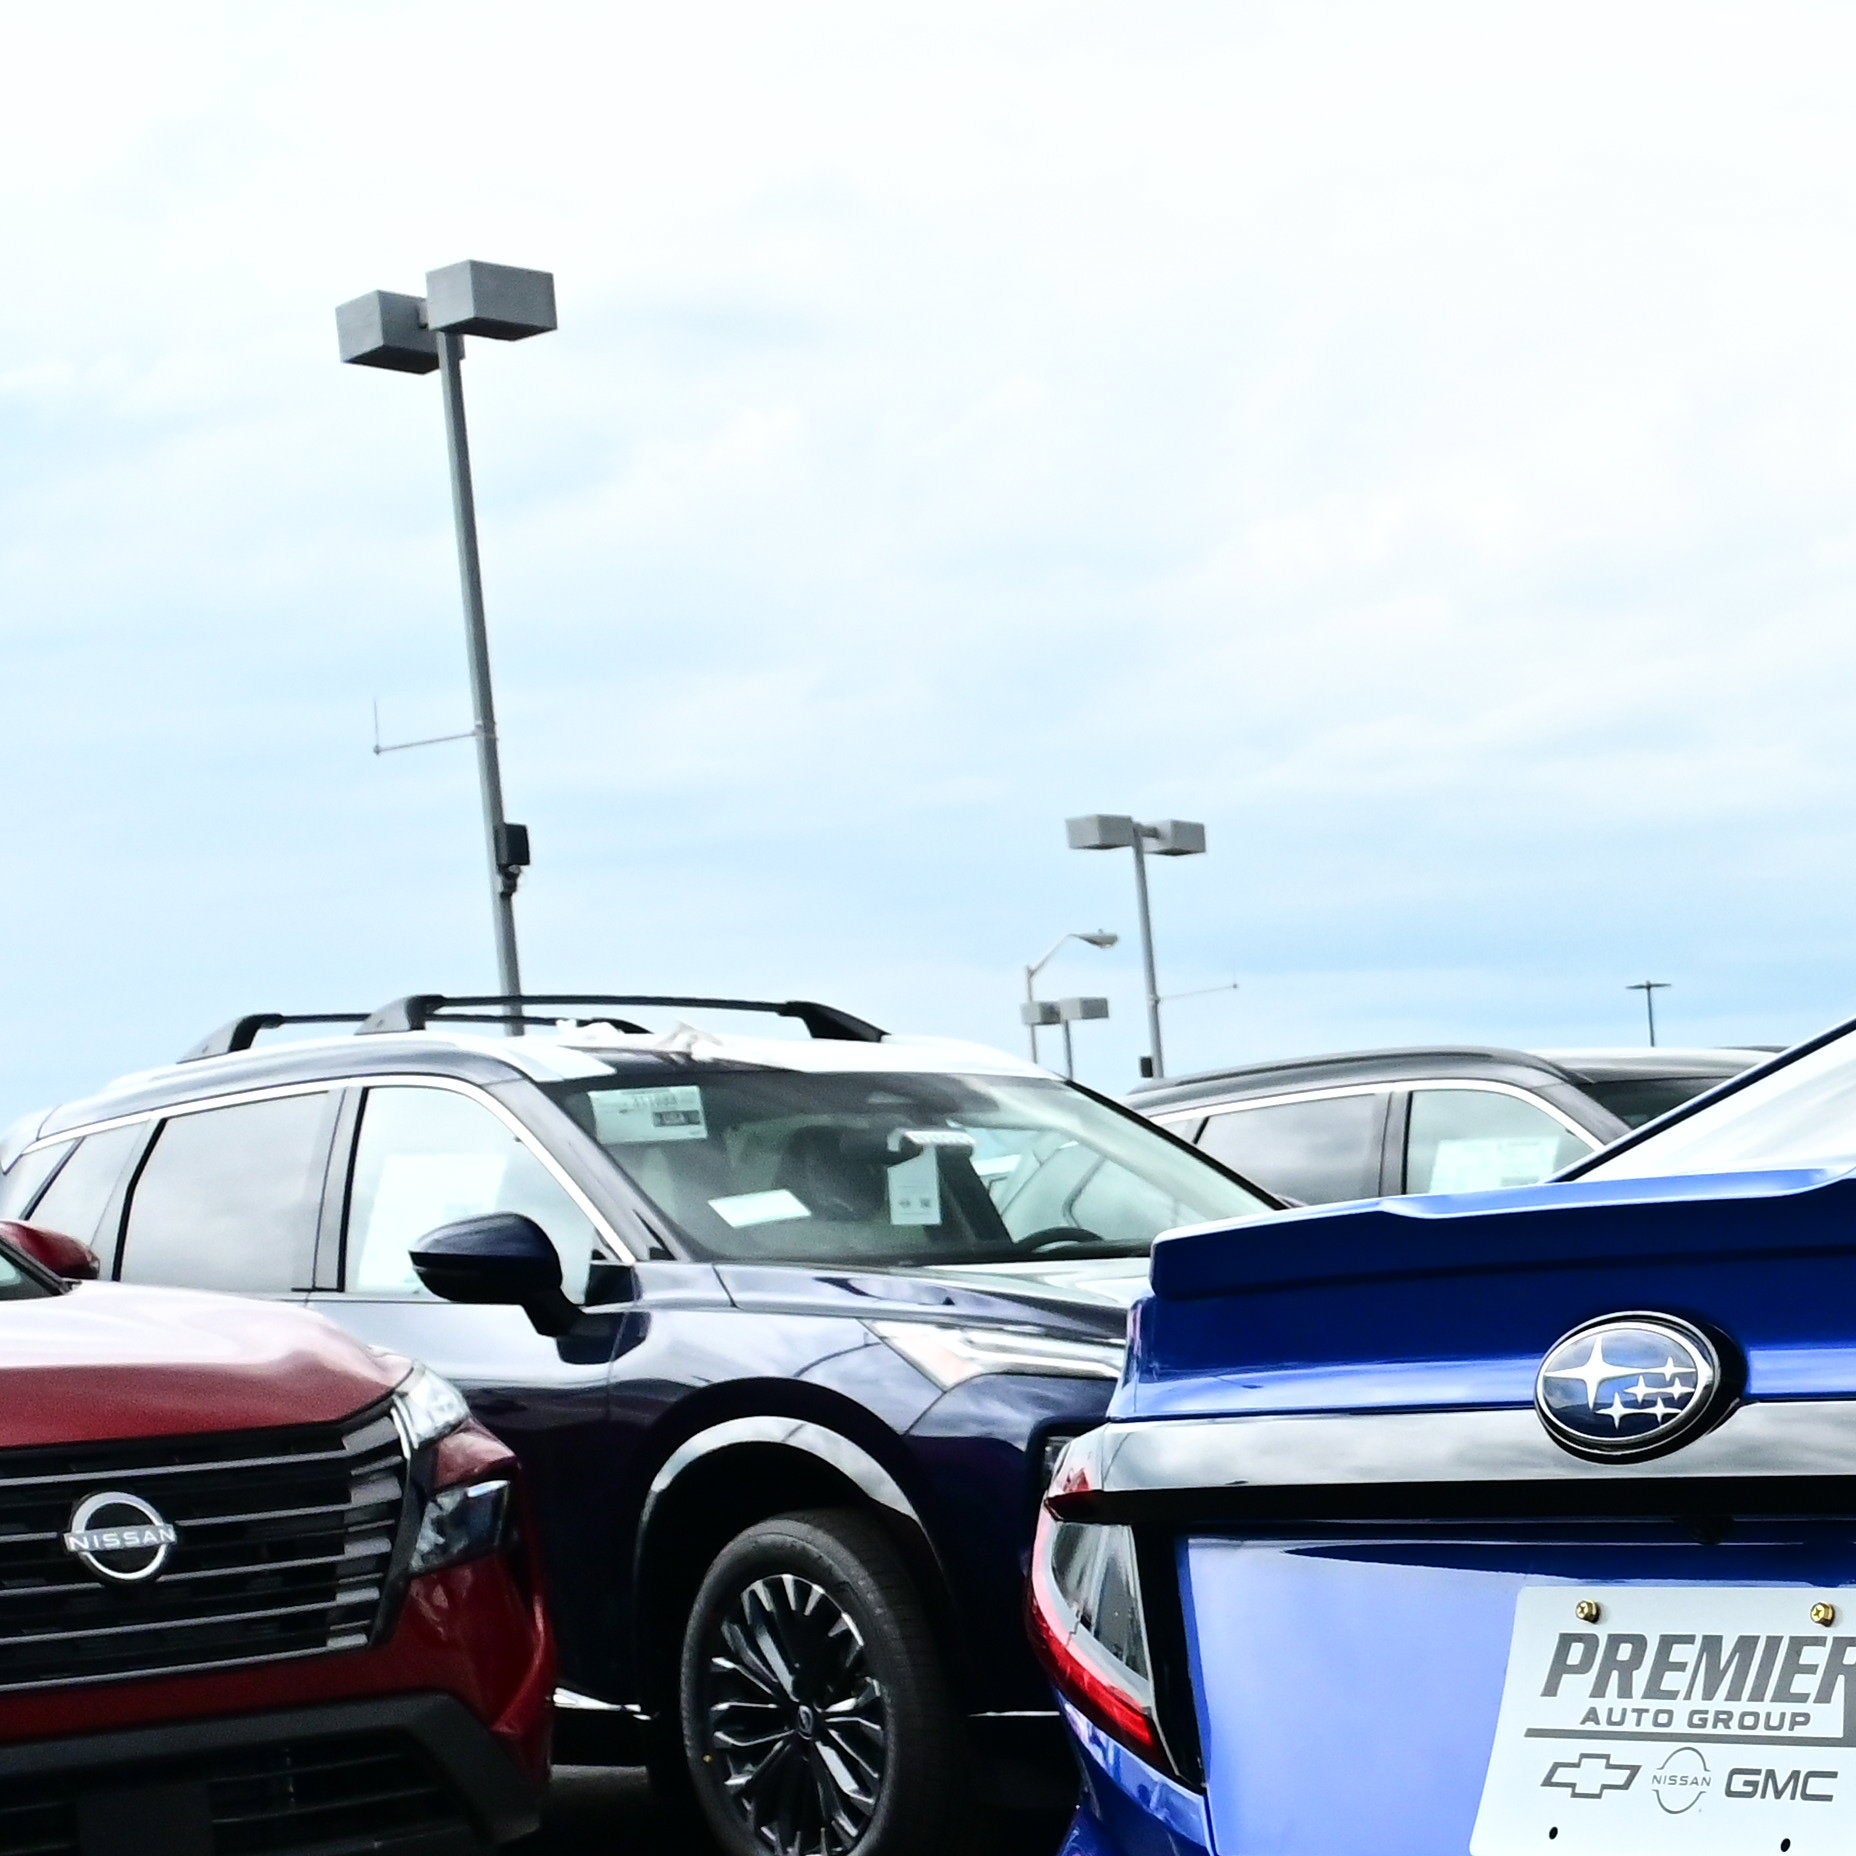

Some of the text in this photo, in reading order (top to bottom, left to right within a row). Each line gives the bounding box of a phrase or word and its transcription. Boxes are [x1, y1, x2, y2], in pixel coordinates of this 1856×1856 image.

[68, 1528, 176, 1550] NISSAN
[1580, 1707, 1811, 1732] AUTO GROUP
[1651, 1768, 1838, 1802] NISSAN GMC
